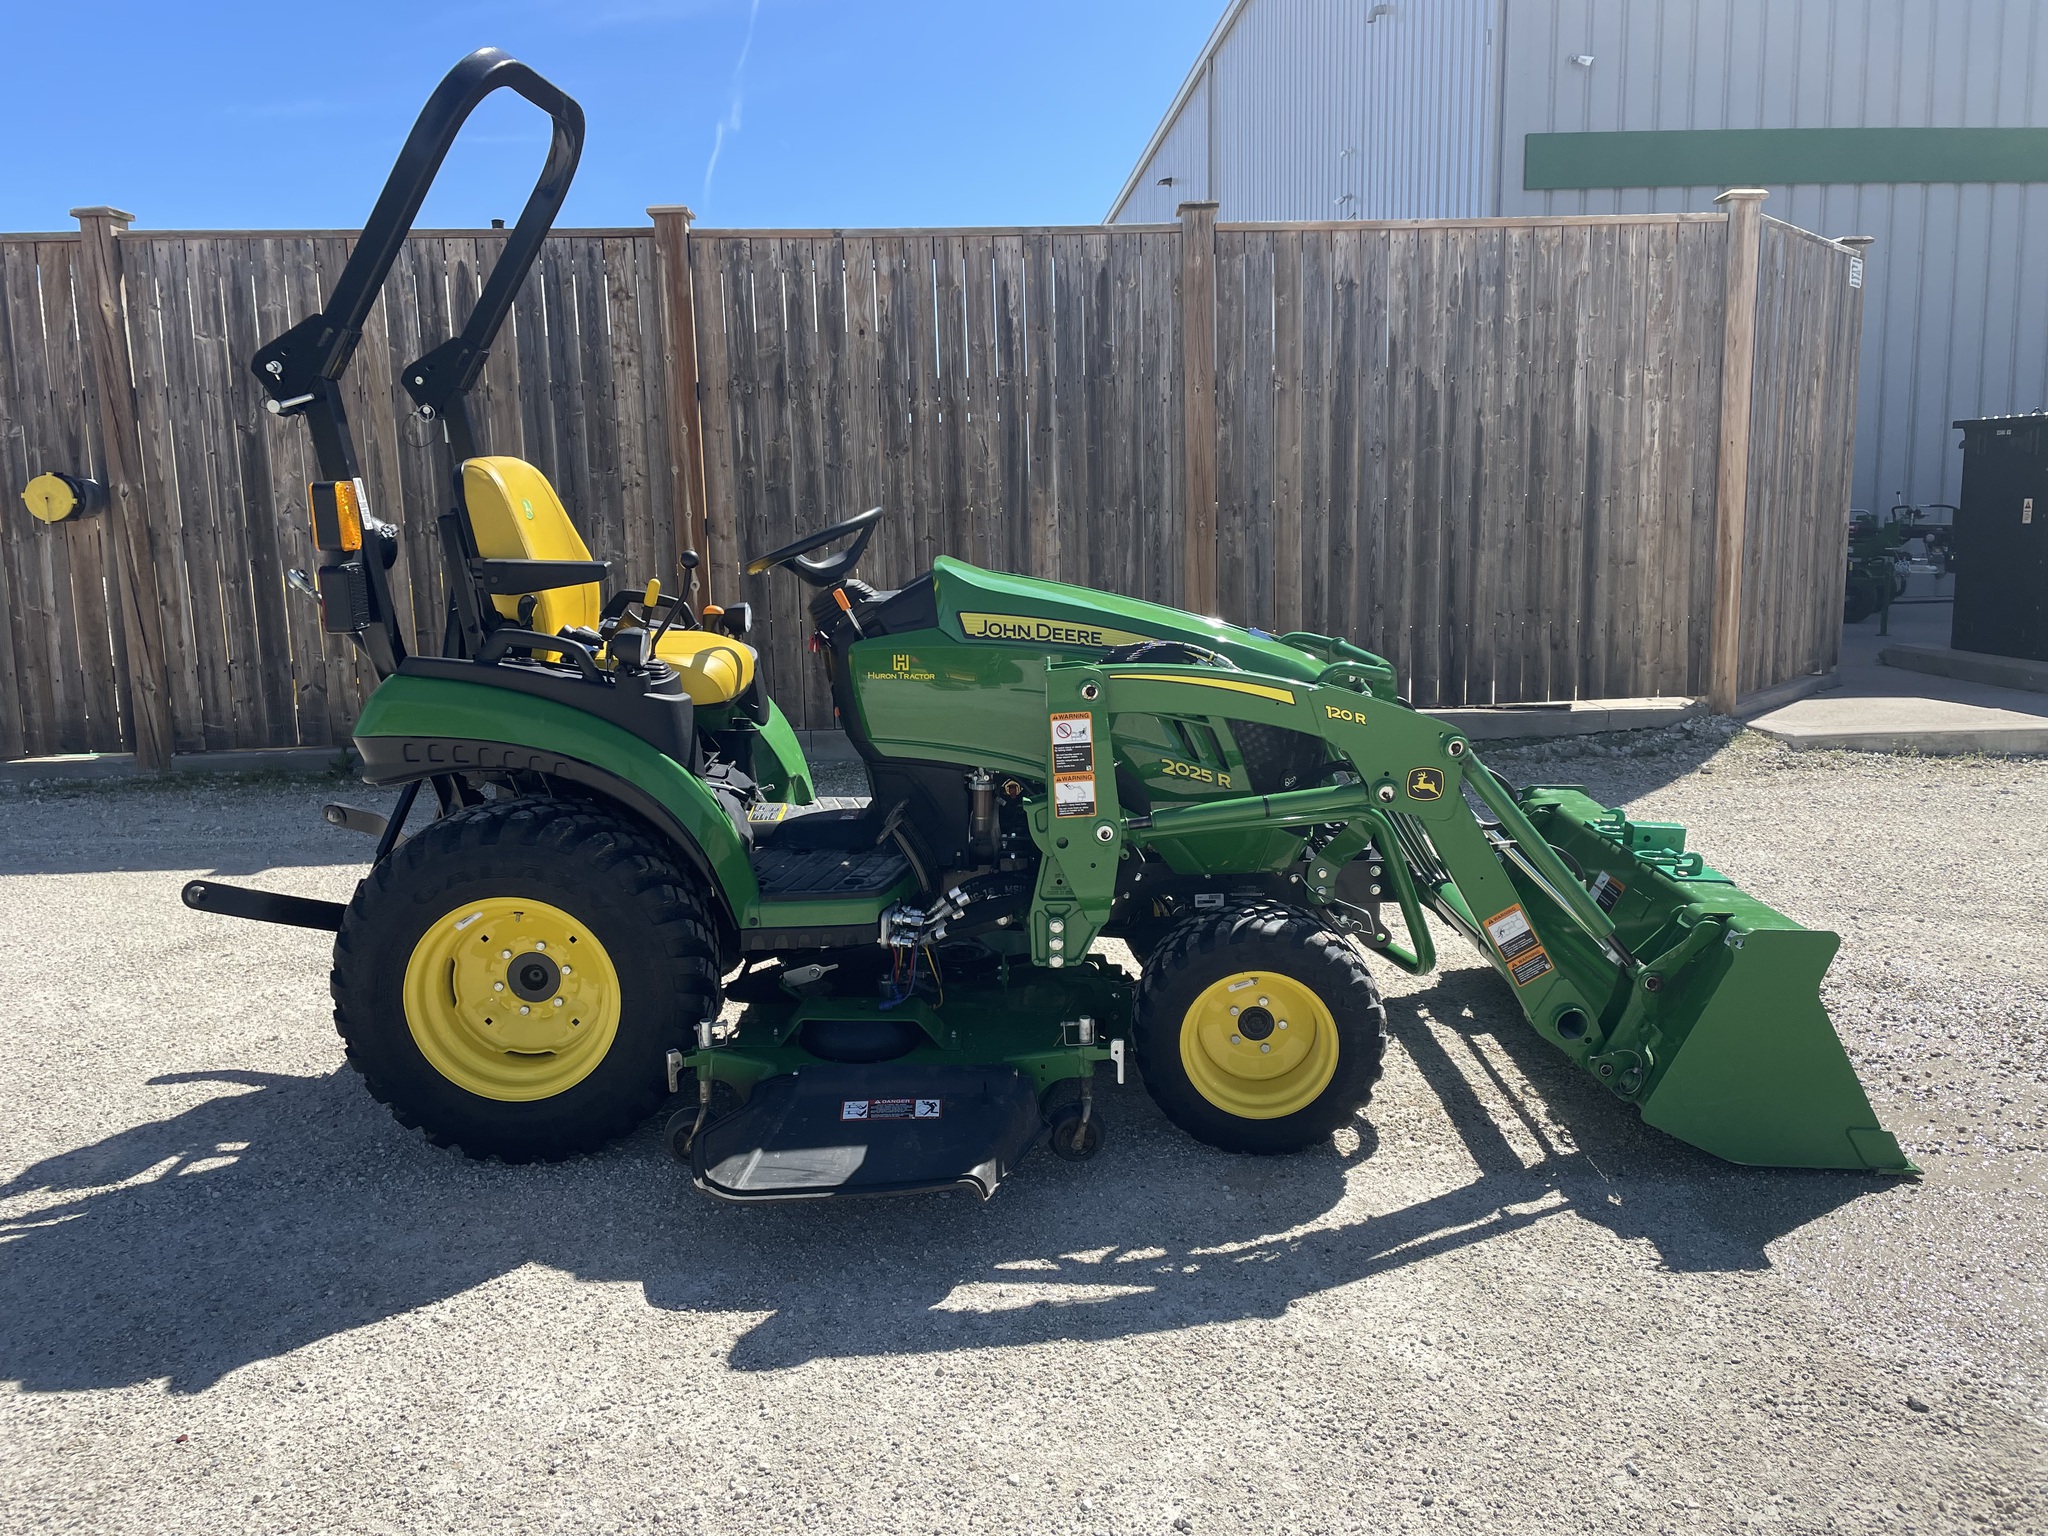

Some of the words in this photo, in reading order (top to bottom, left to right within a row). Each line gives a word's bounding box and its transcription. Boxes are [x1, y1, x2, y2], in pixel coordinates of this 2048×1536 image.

[976, 619, 1031, 638] JOHN
[1036, 623, 1103, 645] DEERE
[867, 671, 897, 680] HURON
[898, 671, 936, 680] TRACTOR
[1058, 712, 1090, 720] WARNING
[1324, 704, 1354, 722] 120
[1354, 711, 1368, 726] R
[1161, 758, 1214, 784] 2025
[1217, 772, 1233, 790] R
